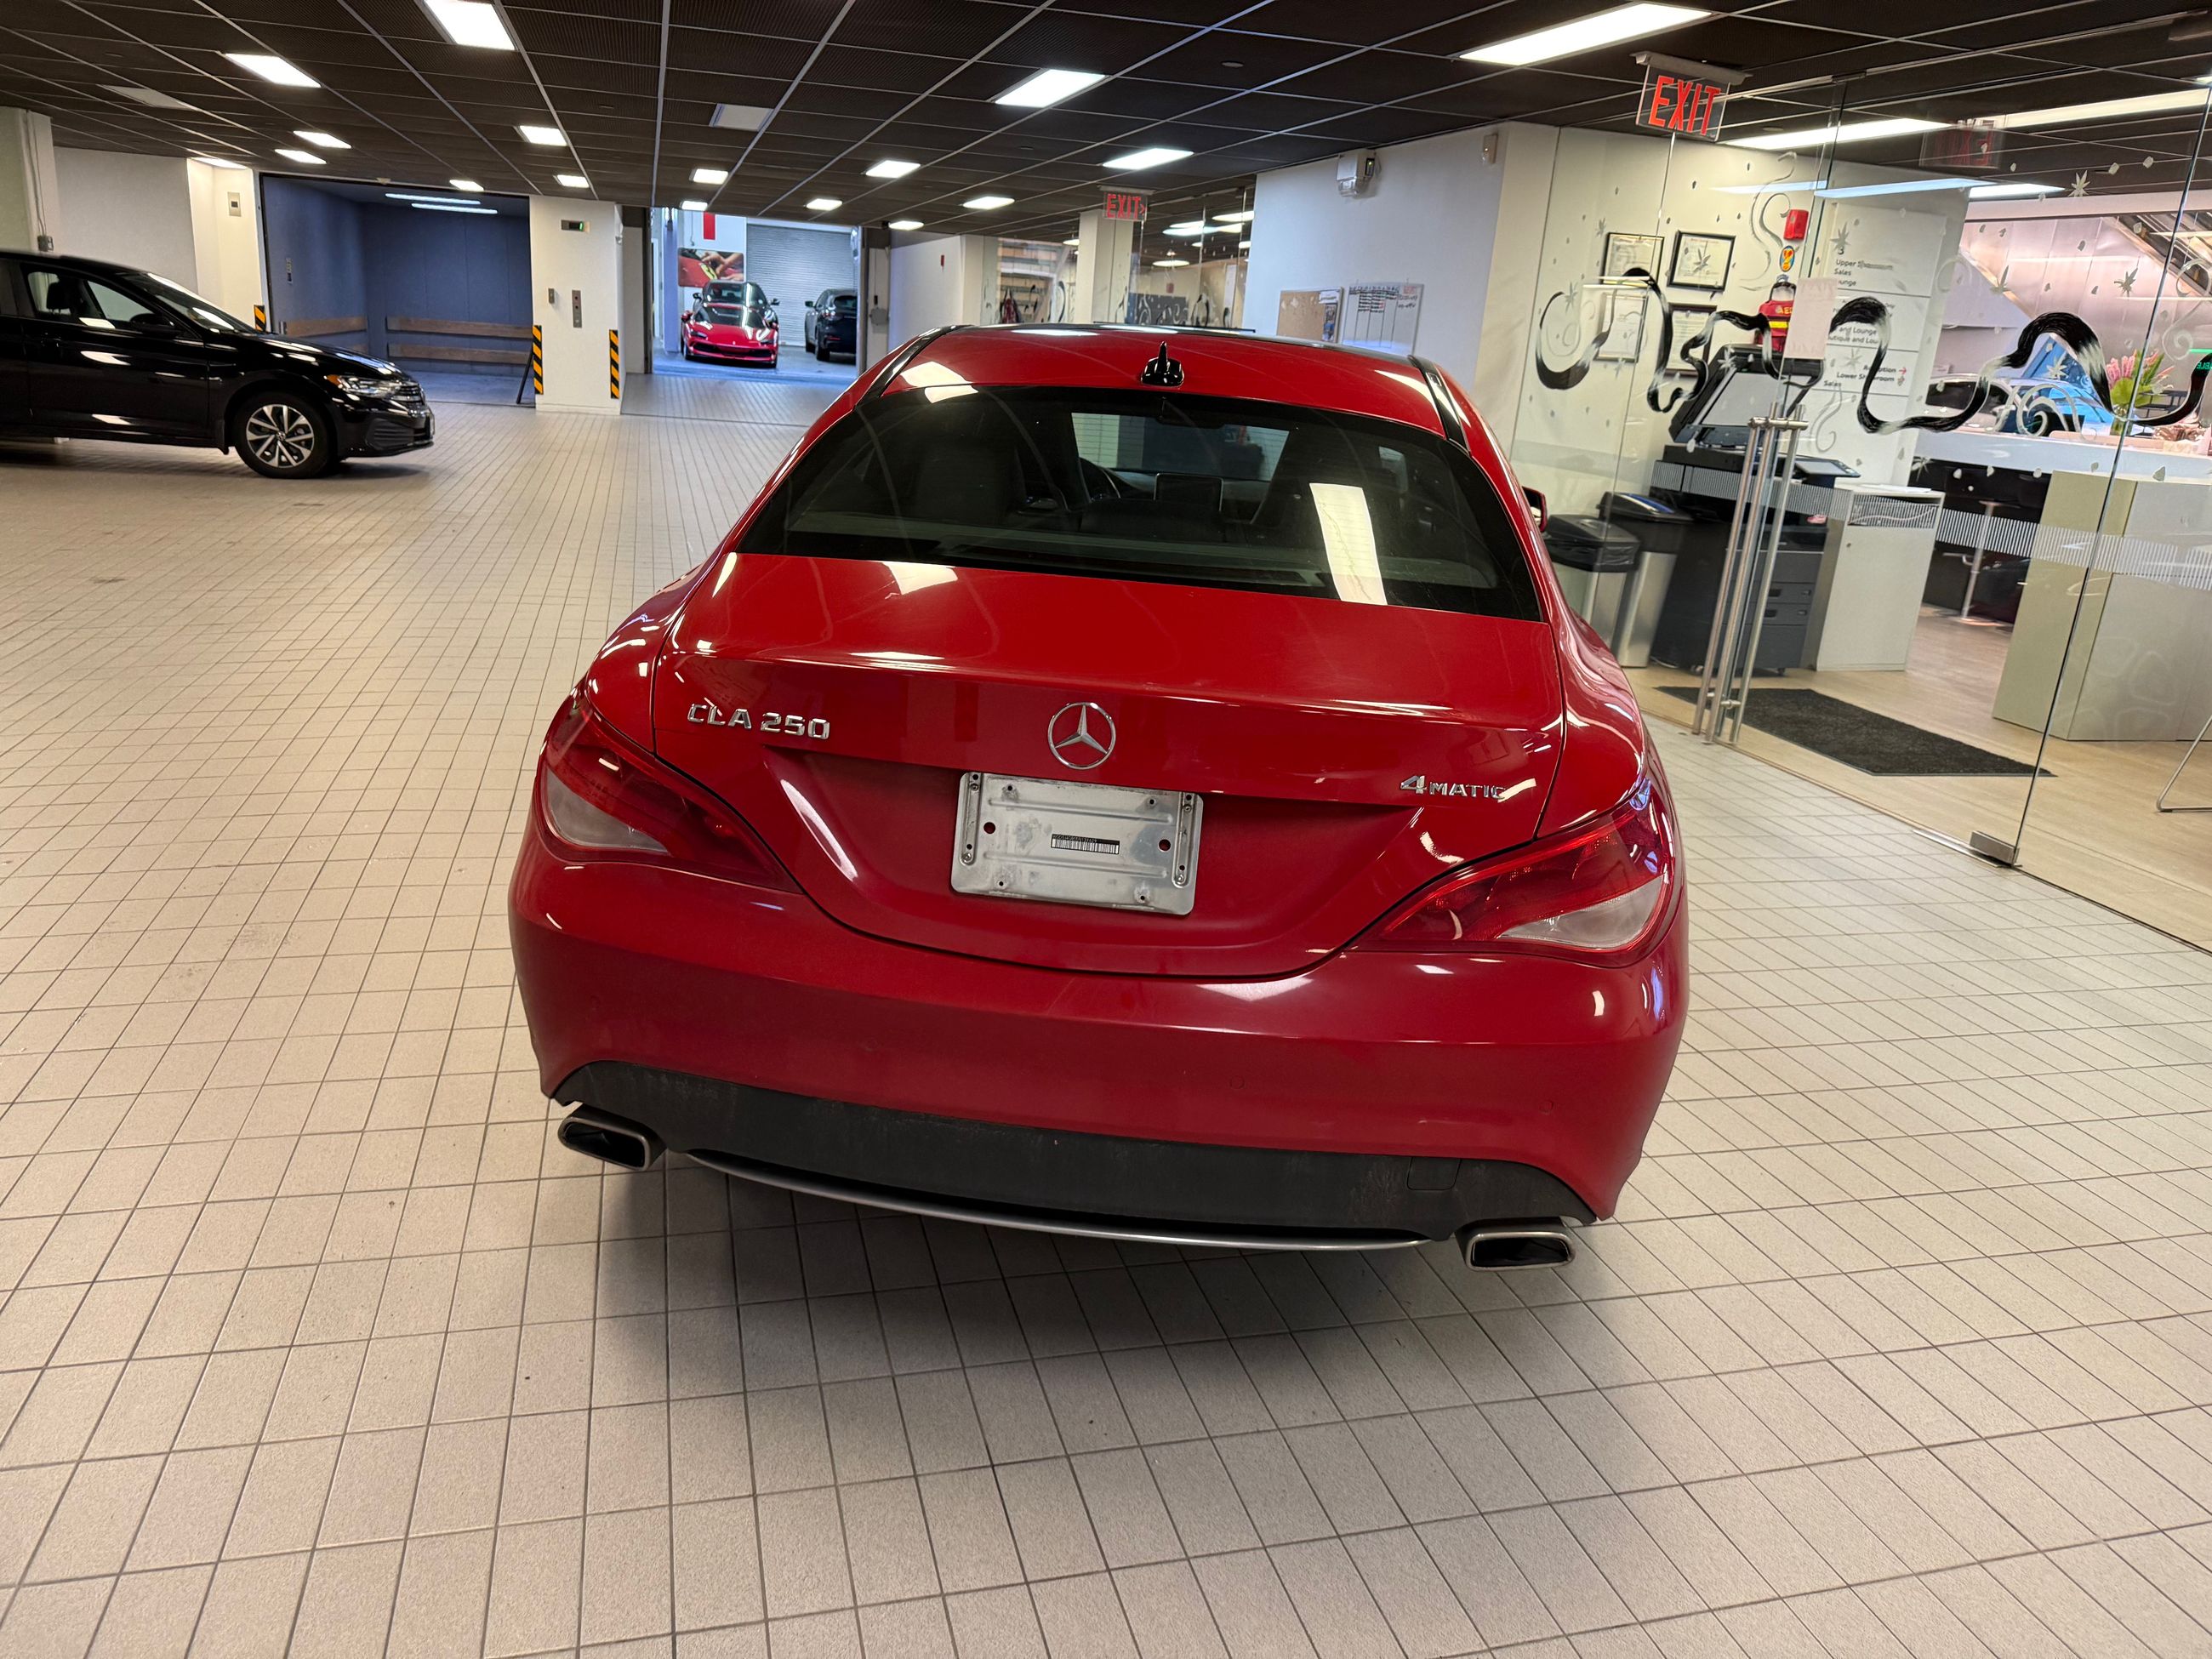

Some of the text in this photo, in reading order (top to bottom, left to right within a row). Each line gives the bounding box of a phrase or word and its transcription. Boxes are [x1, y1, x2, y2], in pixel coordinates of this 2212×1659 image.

[1648, 75, 1722, 136] EXIT
[1107, 193, 1142, 219] EXIT
[1836, 259, 1856, 267] Upper
[1775, 305, 1793, 315] AE
[687, 703, 830, 740] CLA 250
[1400, 775, 1507, 800] 4MATIC
